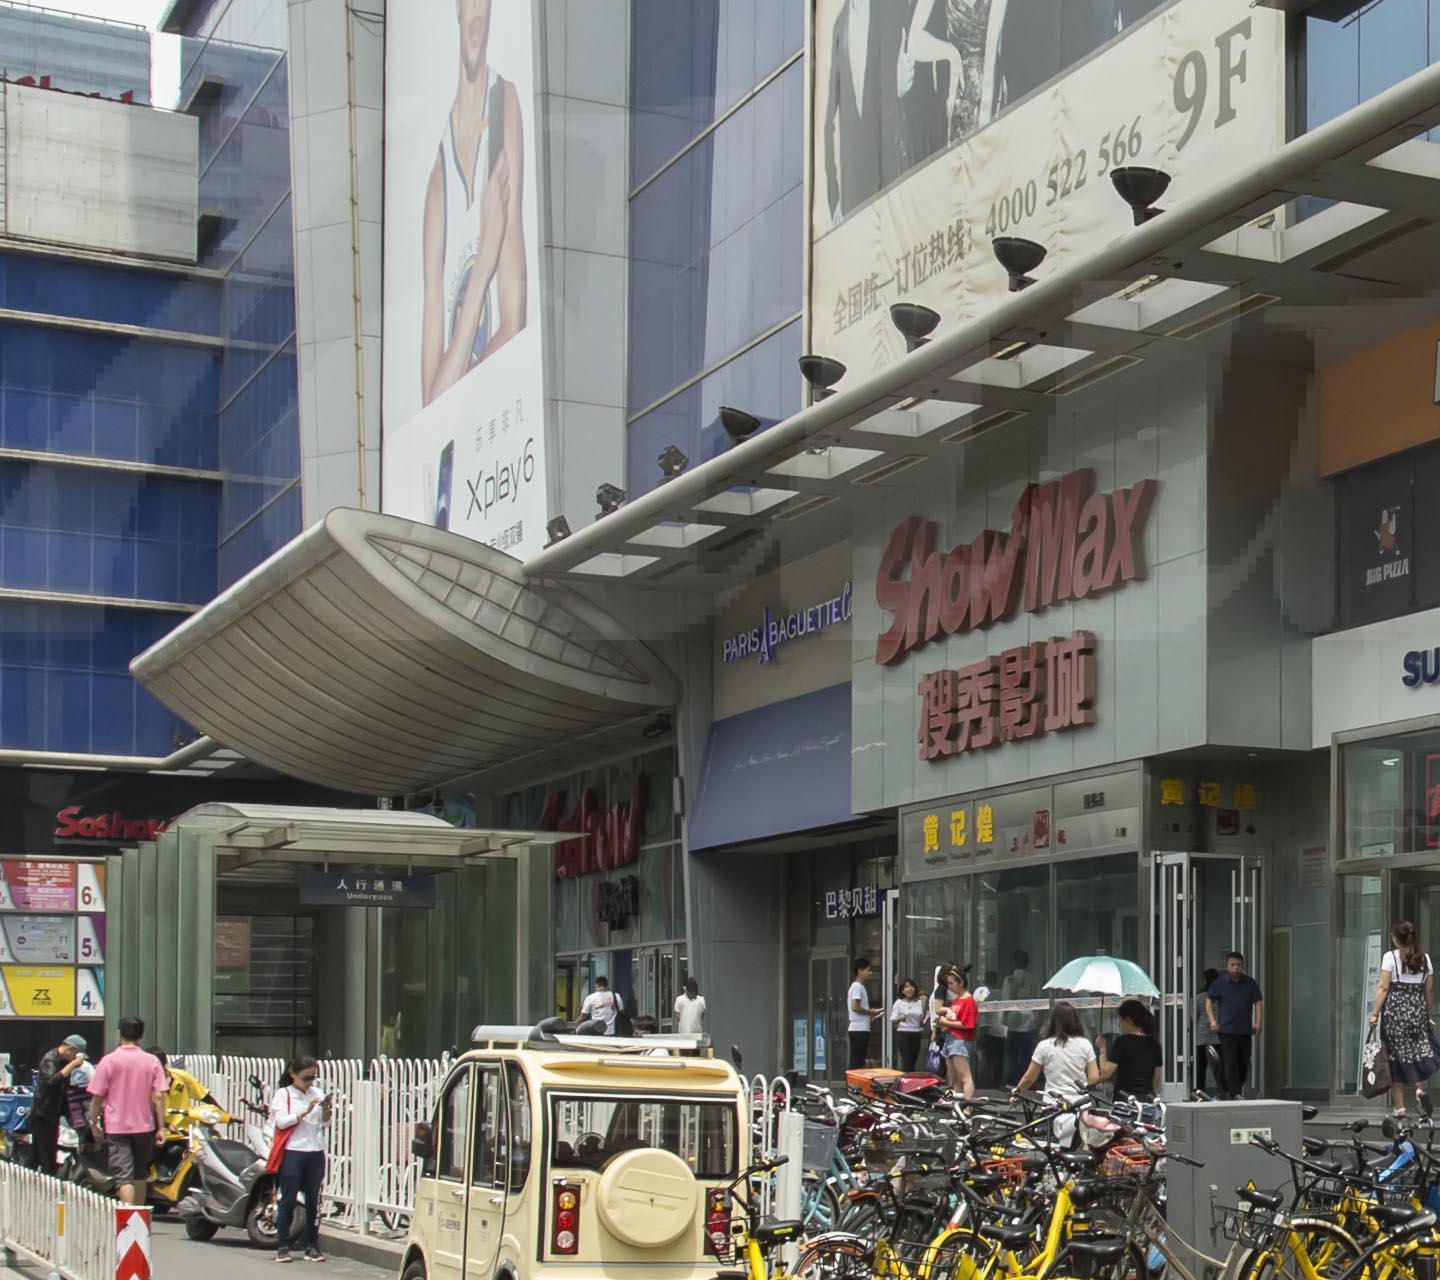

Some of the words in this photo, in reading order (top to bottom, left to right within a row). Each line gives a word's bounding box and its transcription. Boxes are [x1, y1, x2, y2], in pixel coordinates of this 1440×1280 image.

[1172, 16, 1254, 152] 9F
[984, 179, 1037, 238] 4000
[1045, 148, 1088, 207] 522
[1096, 114, 1143, 178] 566
[465, 437, 535, 520] Xplay6
[1365, 565, 1383, 587] BIG
[1383, 557, 1410, 582] PIZZA
[723, 627, 761, 664] PARIS
[769, 595, 842, 647] BAGUETTE
[916, 630, 1097, 762] 搜秀影城
[1160, 778, 1257, 811] 黄记煌
[923, 803, 994, 854] 黄记煌
[336, 878, 403, 892] 人行通道
[825, 886, 878, 920] 巴黎贝甜
